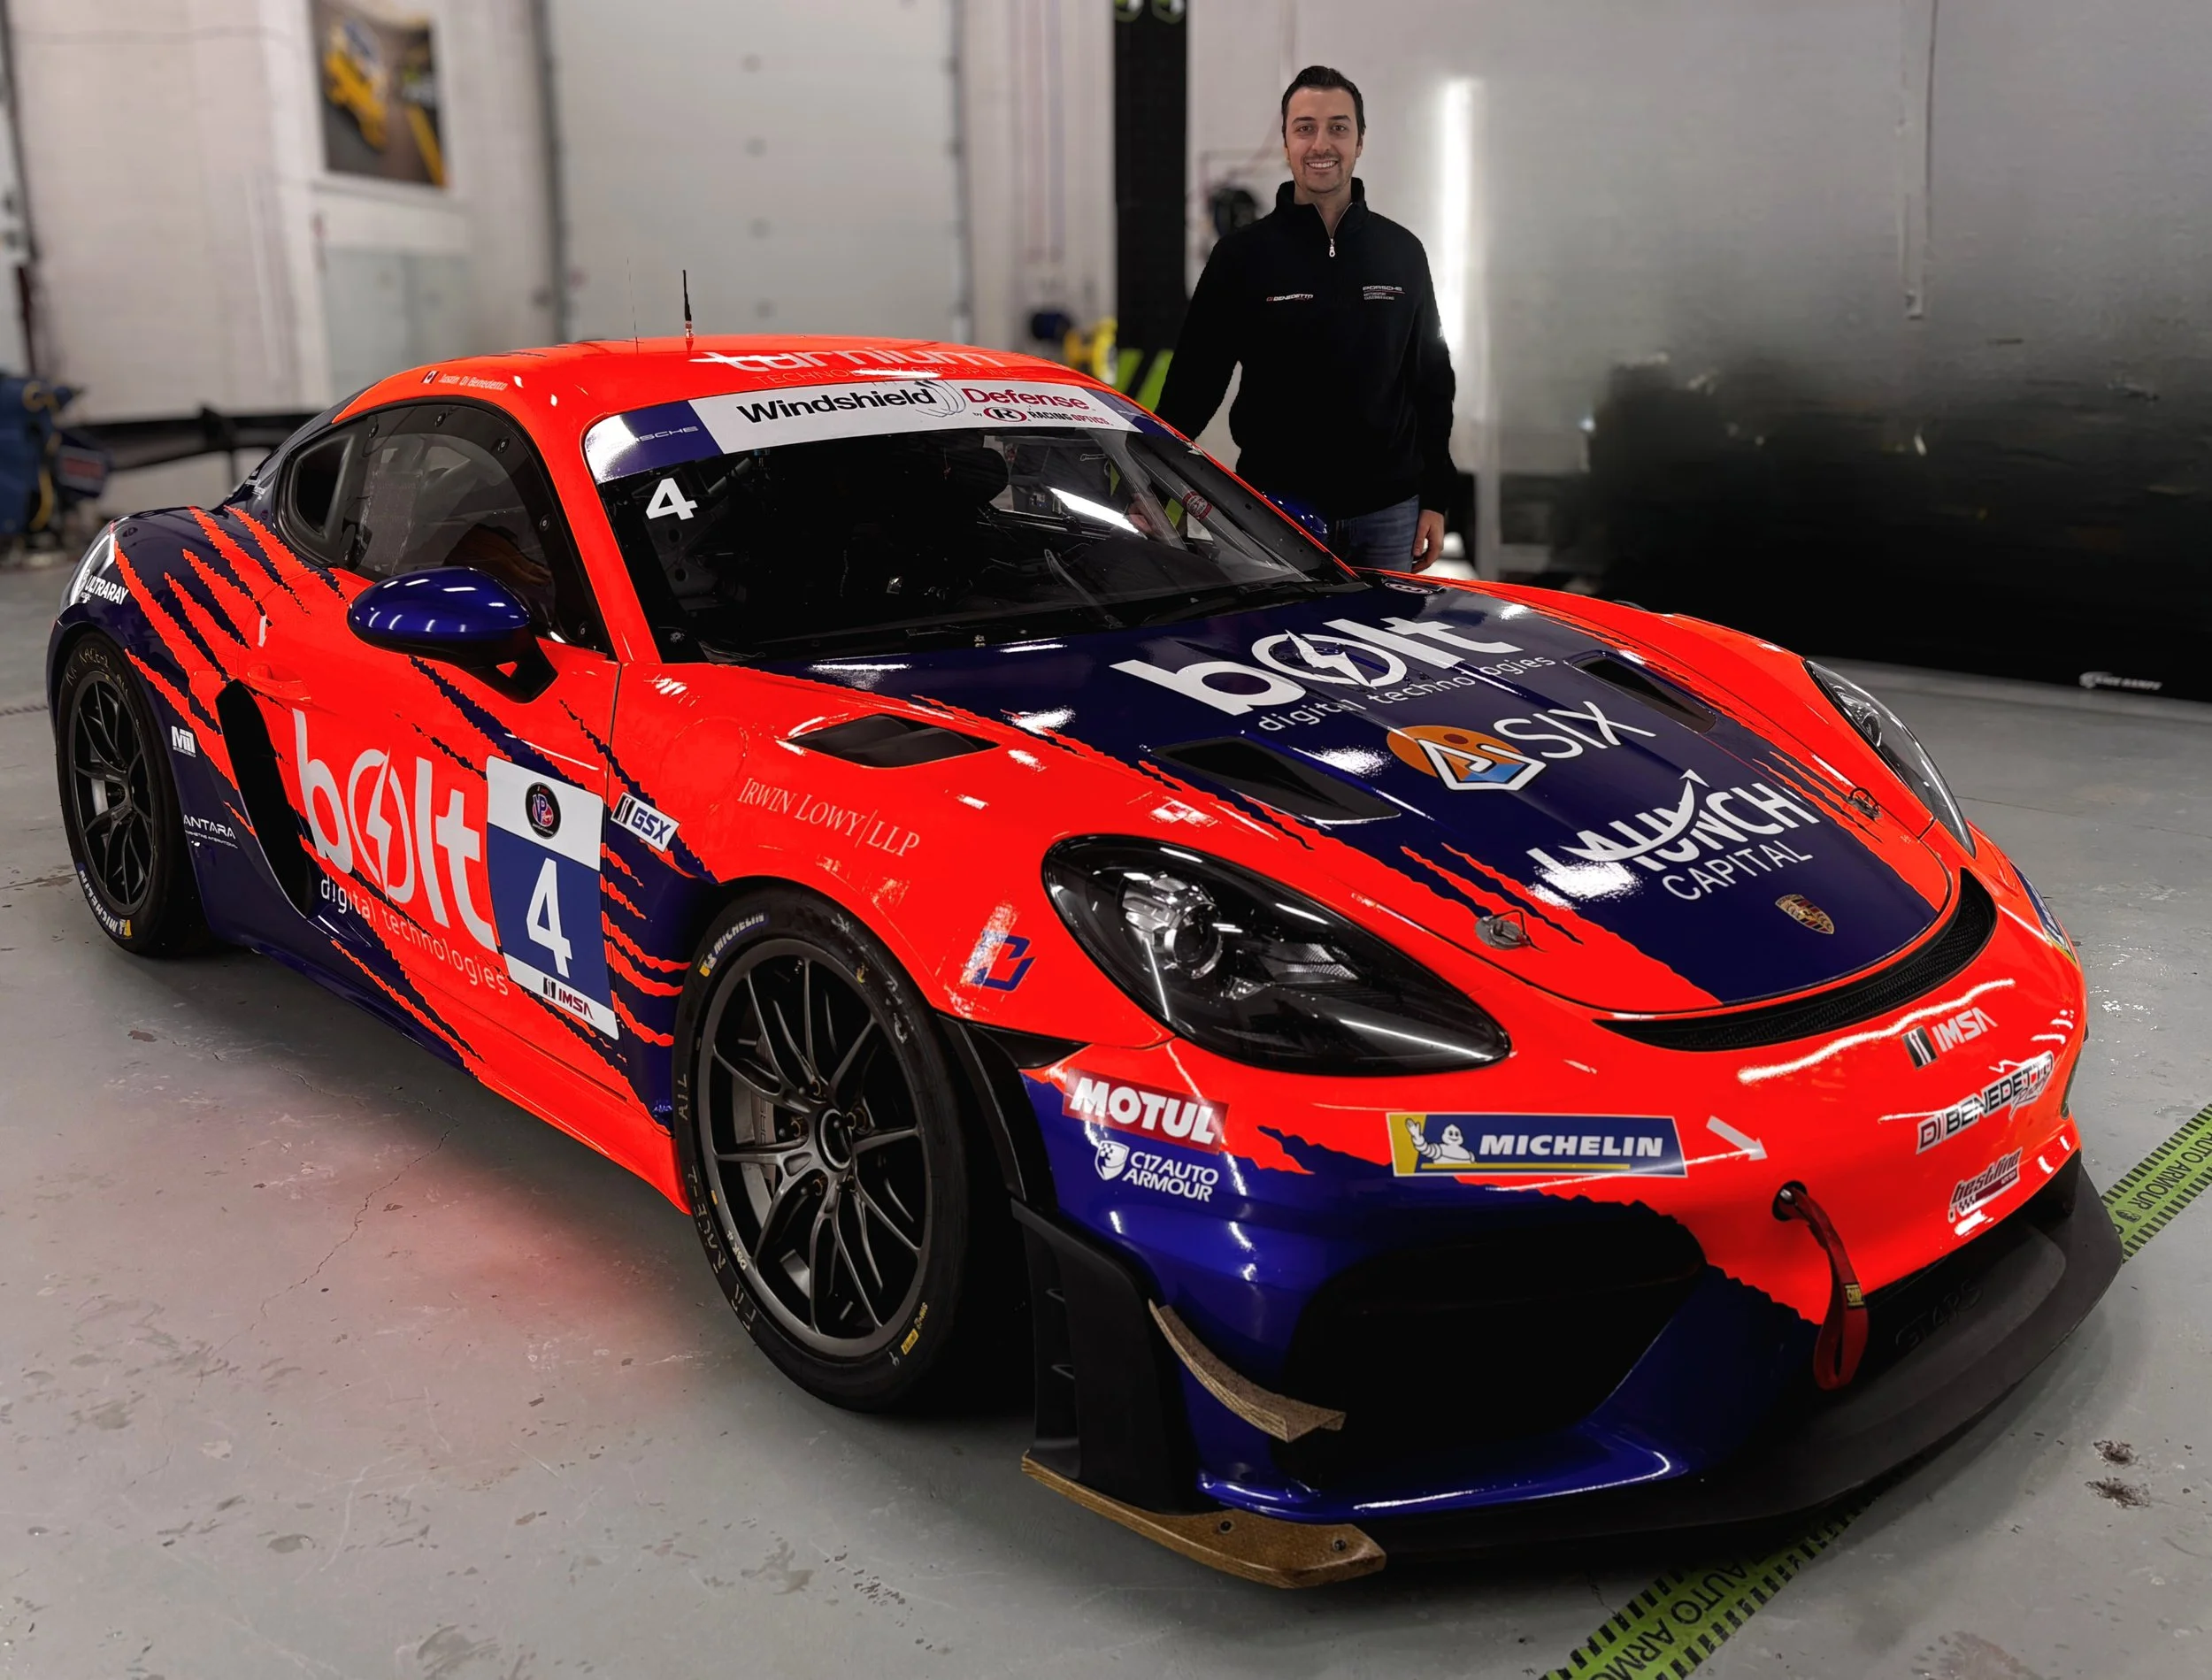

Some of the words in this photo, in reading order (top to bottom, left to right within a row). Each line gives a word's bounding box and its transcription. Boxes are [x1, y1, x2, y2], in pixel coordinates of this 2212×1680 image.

[752, 367, 904, 386] TECHNO
[961, 387, 1090, 410] Defense
[737, 387, 937, 424] Windshield
[645, 477, 698, 520] 4
[84, 575, 129, 605] ULTRARAY
[1110, 617, 1524, 715] bolt
[1368, 656, 1555, 704] technoogies
[1494, 701, 1656, 759] SIX
[292, 707, 498, 953] bolt
[631, 806, 672, 844] GSX
[737, 778, 797, 814] IRWIN
[867, 820, 920, 857] LLP
[1662, 840, 1813, 901] CAPITAL
[79, 870, 119, 933] MICHELIN
[526, 857, 573, 978] 4
[320, 875, 377, 922] digital
[381, 906, 509, 996] technologies
[713, 912, 764, 955] MICHELIN
[558, 987, 595, 1021] IMSA
[1932, 1007, 1998, 1052] IMSA
[1069, 1077, 1215, 1145] MOTUL
[1479, 1134, 1664, 1158] MICHELIN
[1122, 1167, 1213, 1202] ARMOUR
[2127, 1160, 2193, 1211] ARMOUR
[1671, 1561, 1747, 1625] AUTO
[1590, 1618, 1676, 1680] ARM
